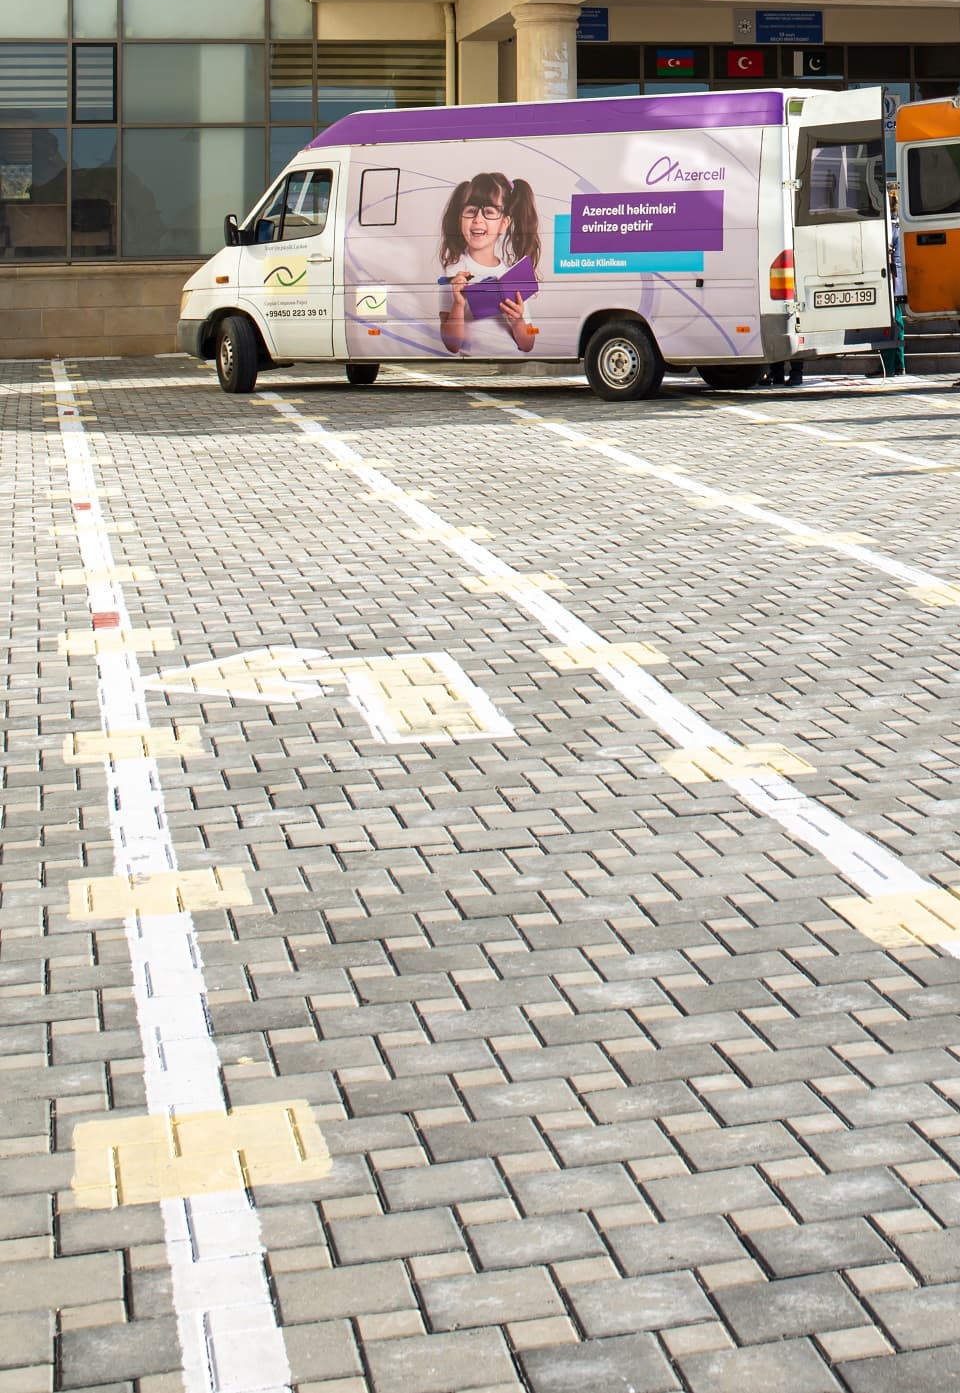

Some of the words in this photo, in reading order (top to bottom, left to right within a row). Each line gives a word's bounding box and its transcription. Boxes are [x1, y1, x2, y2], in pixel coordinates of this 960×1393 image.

[674, 167, 725, 182] Azercell
[582, 203, 625, 217] Azercell
[627, 202, 677, 216] həkimləri
[582, 221, 618, 234] evinizə
[620, 220, 653, 234] gətirir
[560, 259, 580, 268] Mobil
[265, 310, 291, 318] +99450
[292, 309, 306, 317] 223
[307, 308, 317, 317] 39
[318, 308, 327, 316] 01
